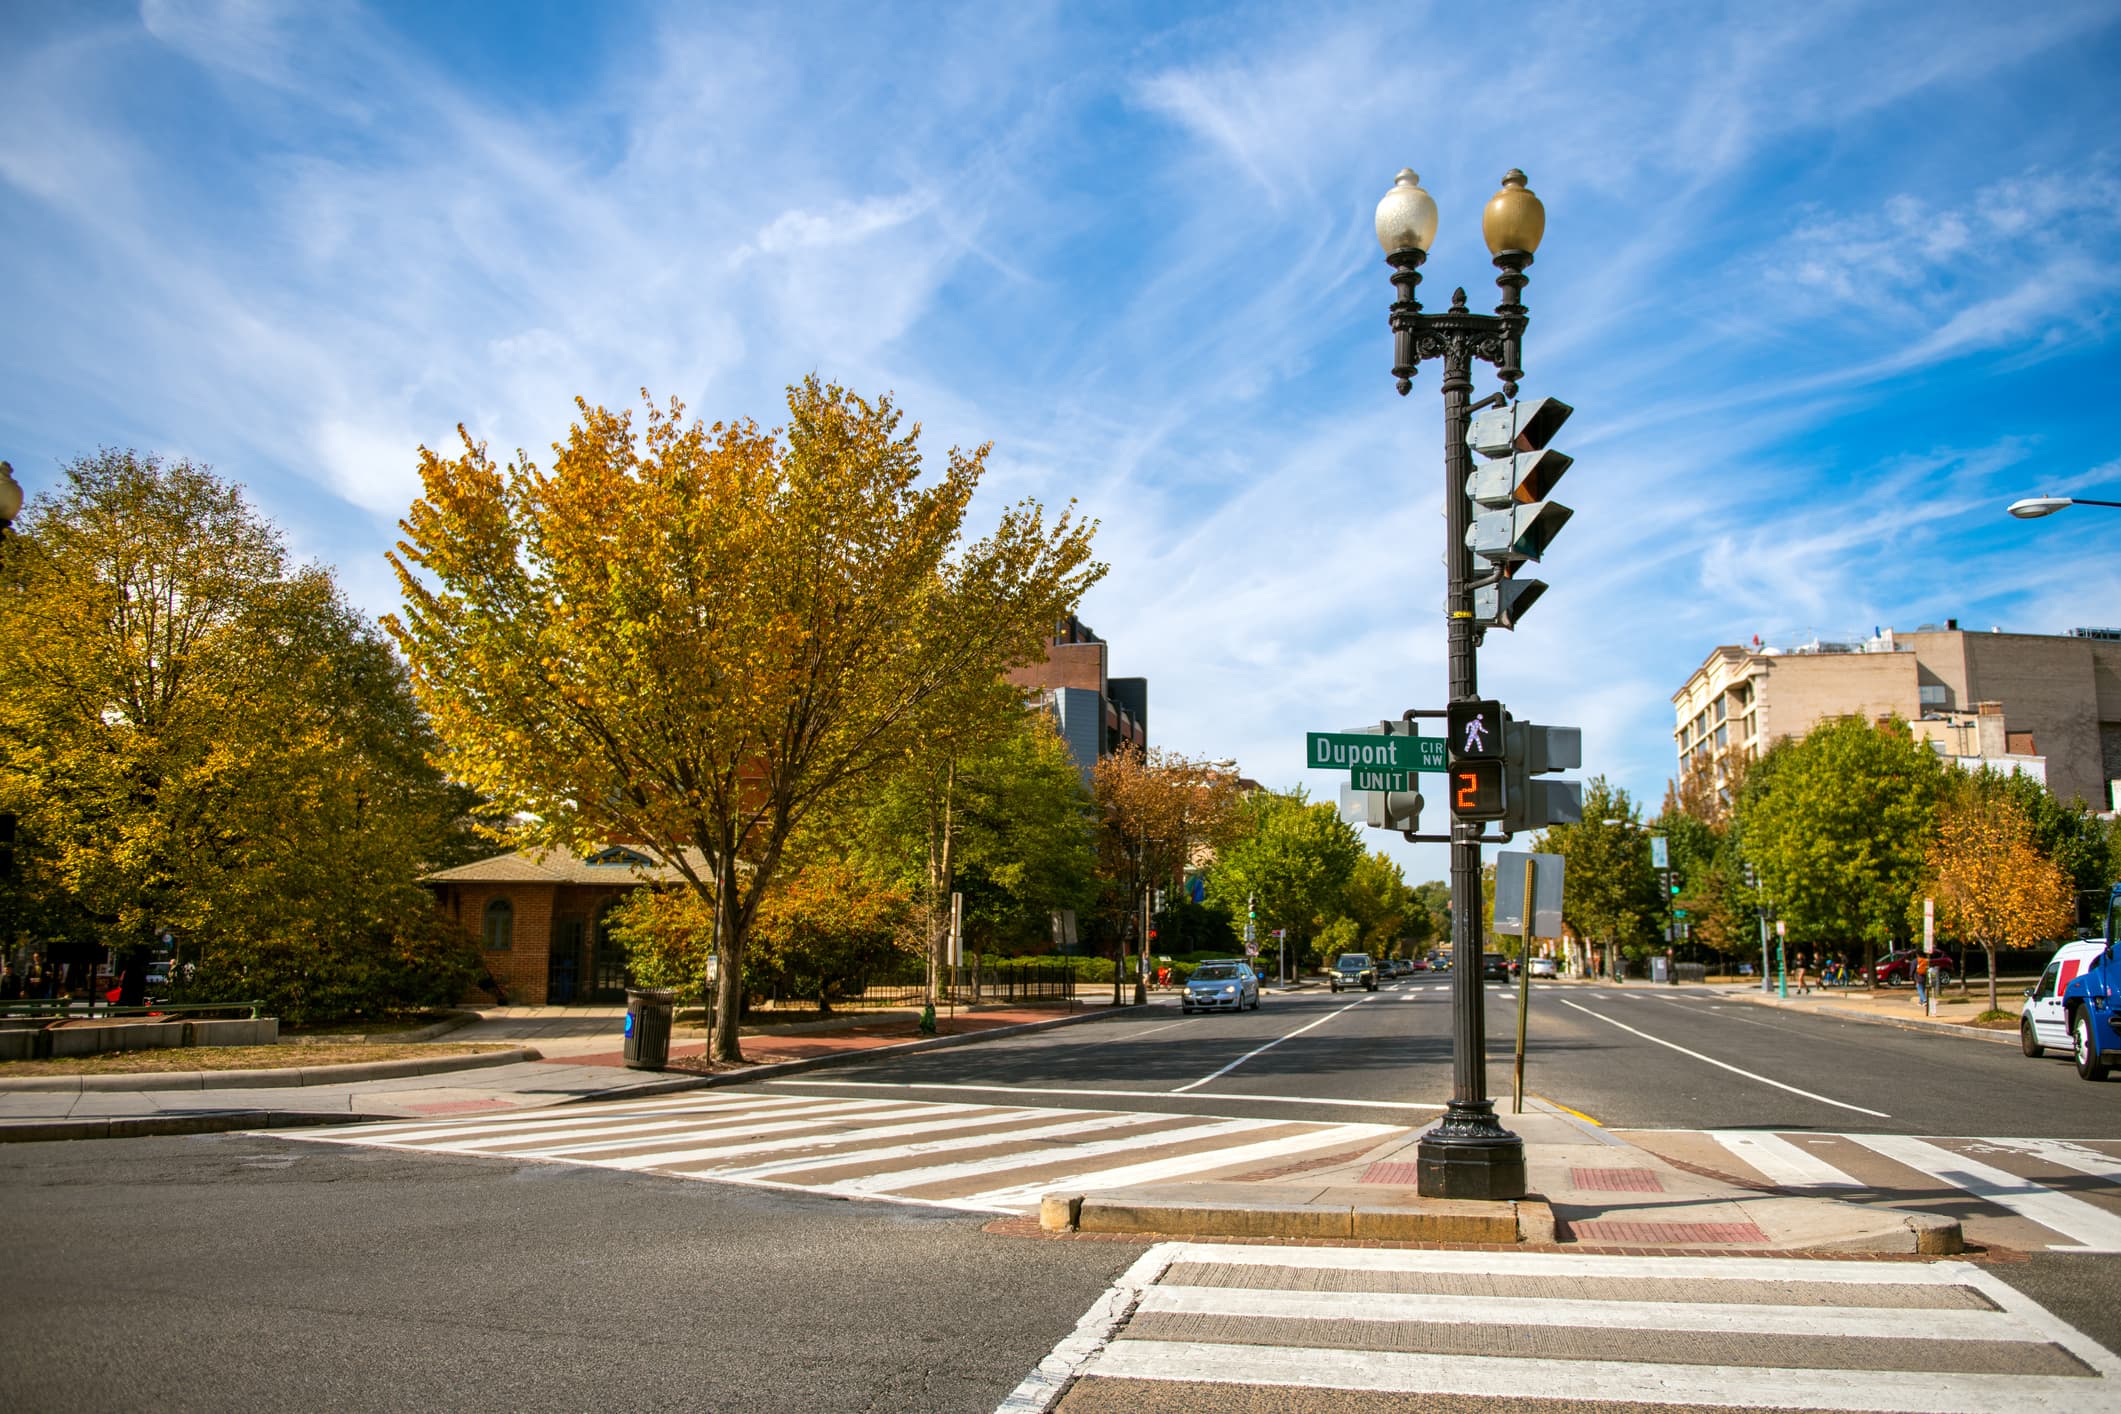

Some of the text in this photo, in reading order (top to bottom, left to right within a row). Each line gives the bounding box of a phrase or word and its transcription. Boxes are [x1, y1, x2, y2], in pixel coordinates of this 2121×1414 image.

[1317, 737, 1397, 767] Dupont
[1420, 741, 1443, 753] CIR
[1423, 754, 1443, 766] NW
[1360, 771, 1402, 791] UNIT
[1457, 773, 1477, 807] 2
